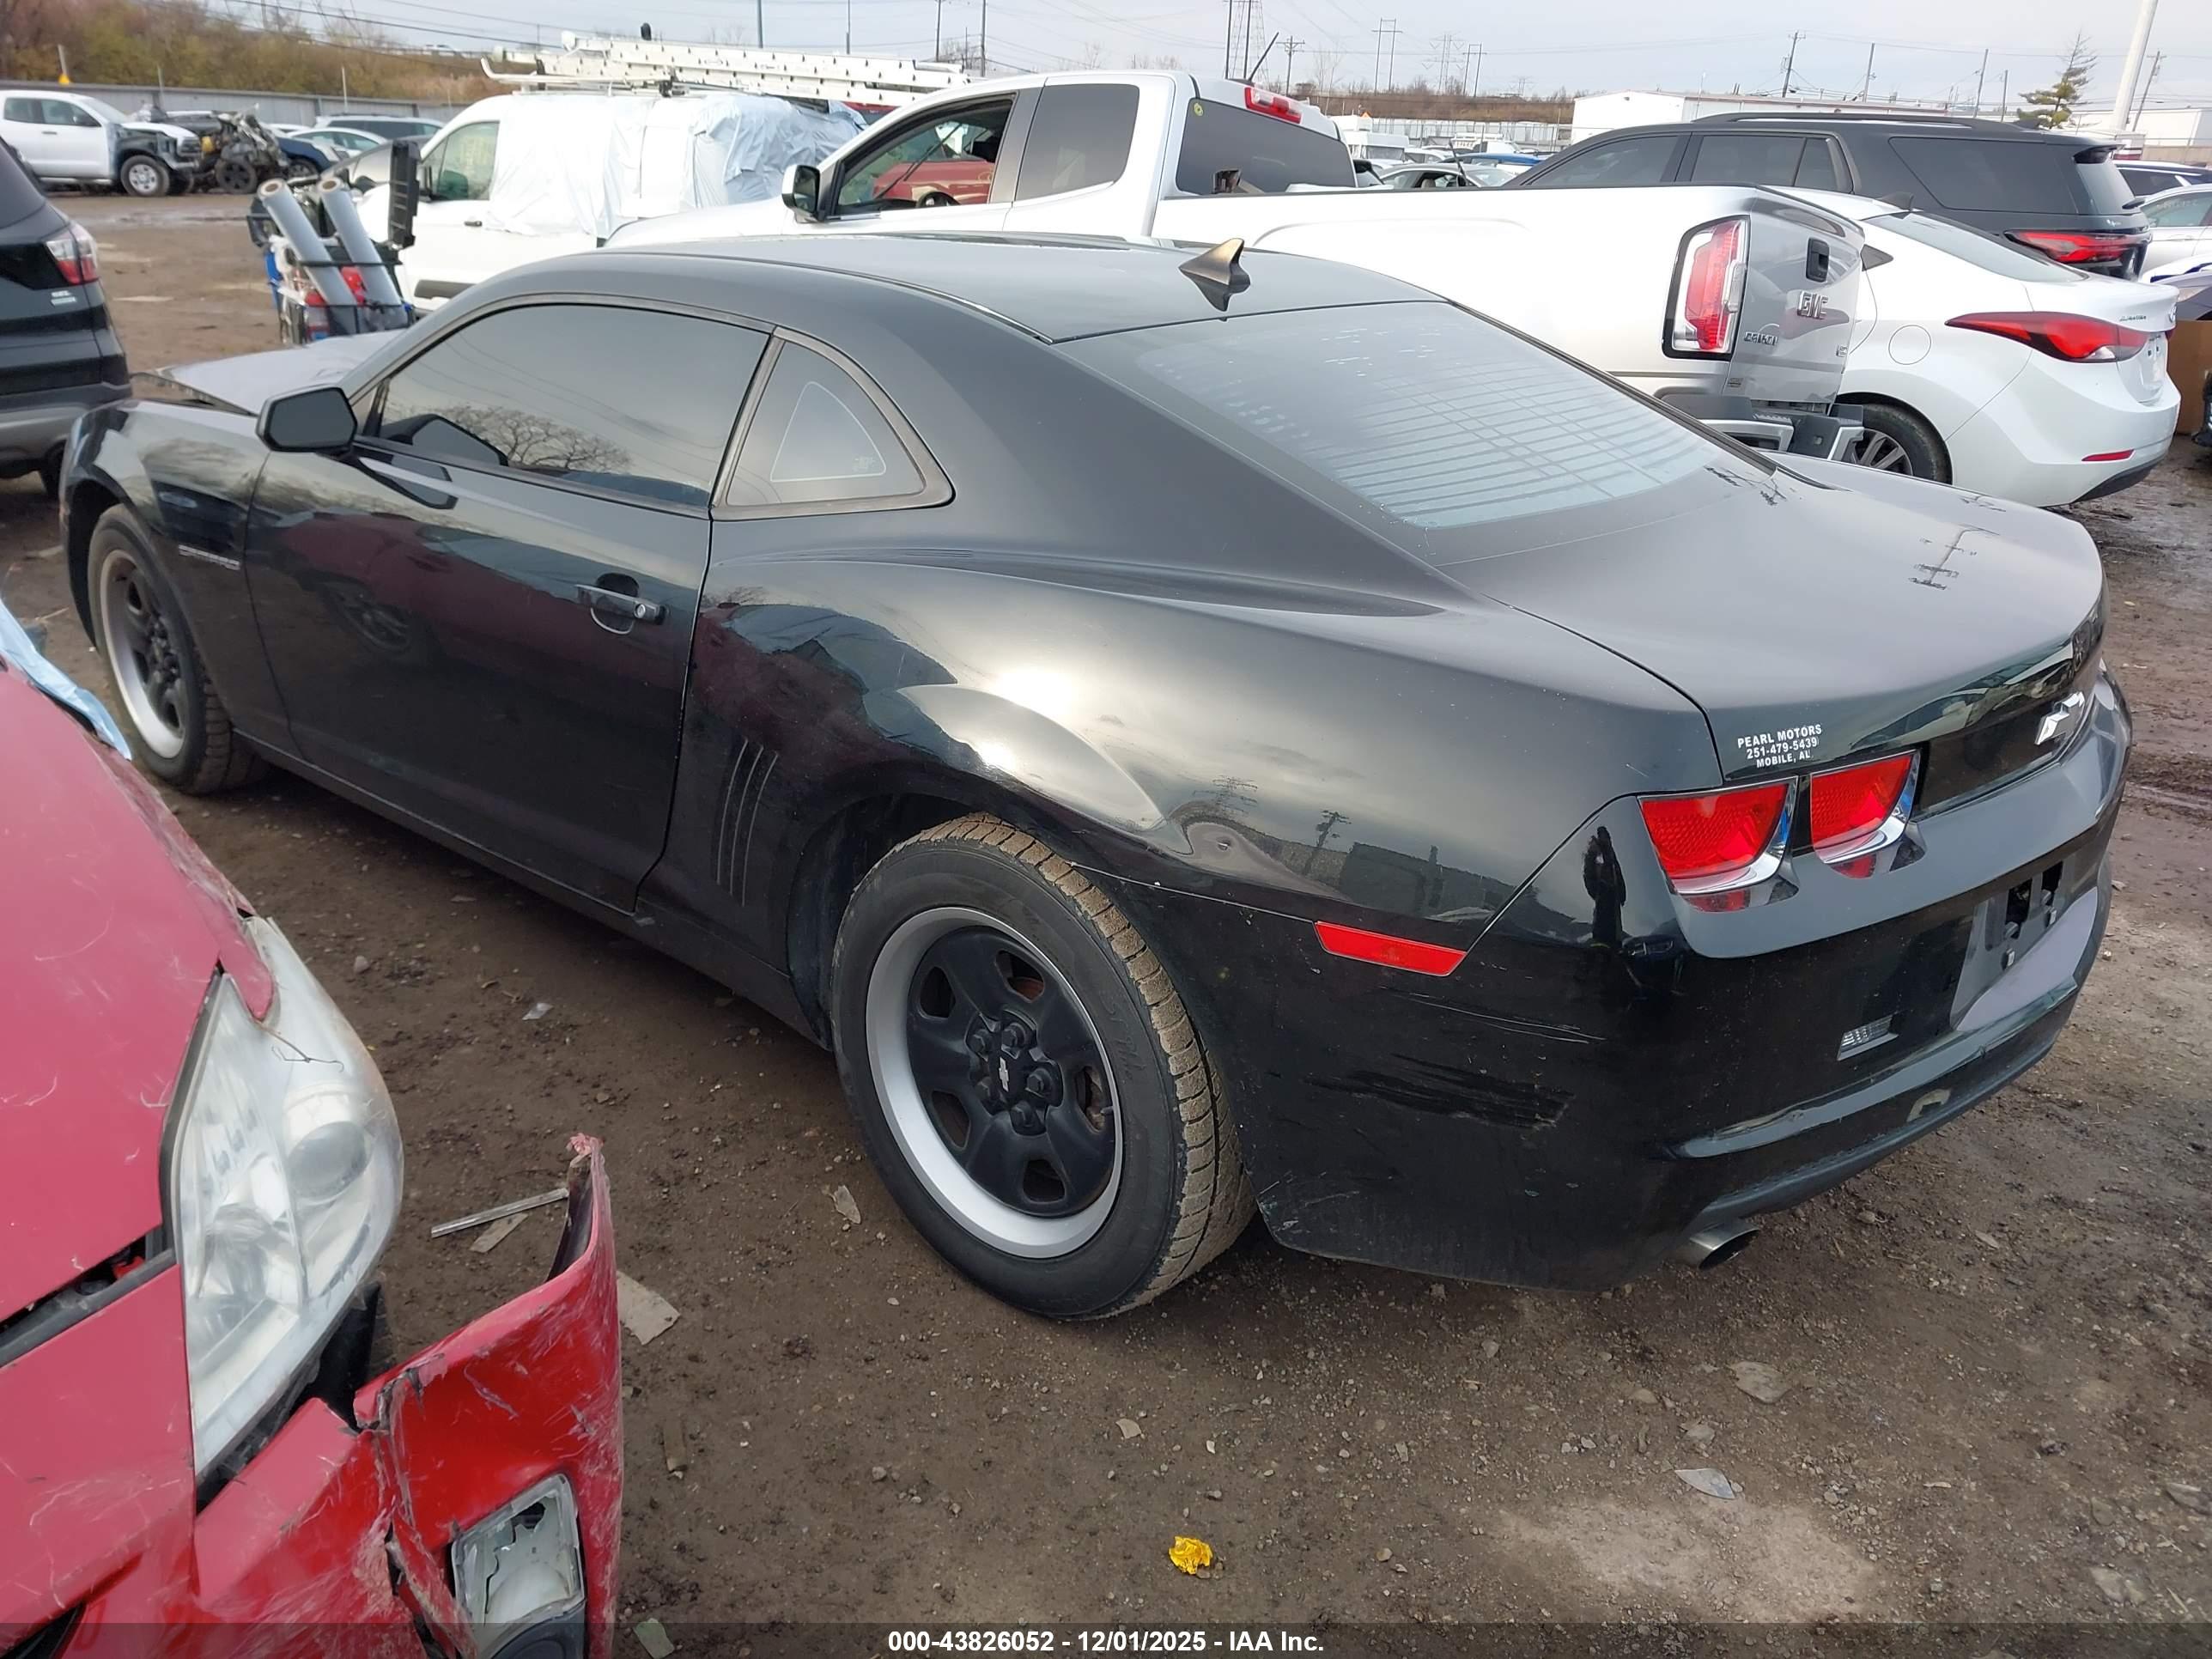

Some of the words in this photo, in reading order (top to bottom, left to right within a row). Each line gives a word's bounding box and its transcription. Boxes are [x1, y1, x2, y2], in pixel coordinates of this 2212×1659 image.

[1797, 290, 1828, 319] GMC
[1737, 733, 1775, 749] PEARL
[1777, 724, 1822, 742] MOTORS
[1746, 737, 1818, 759] 251-479-5439
[1756, 753, 1796, 769] MOBILE,
[1799, 750, 1811, 760] AL
